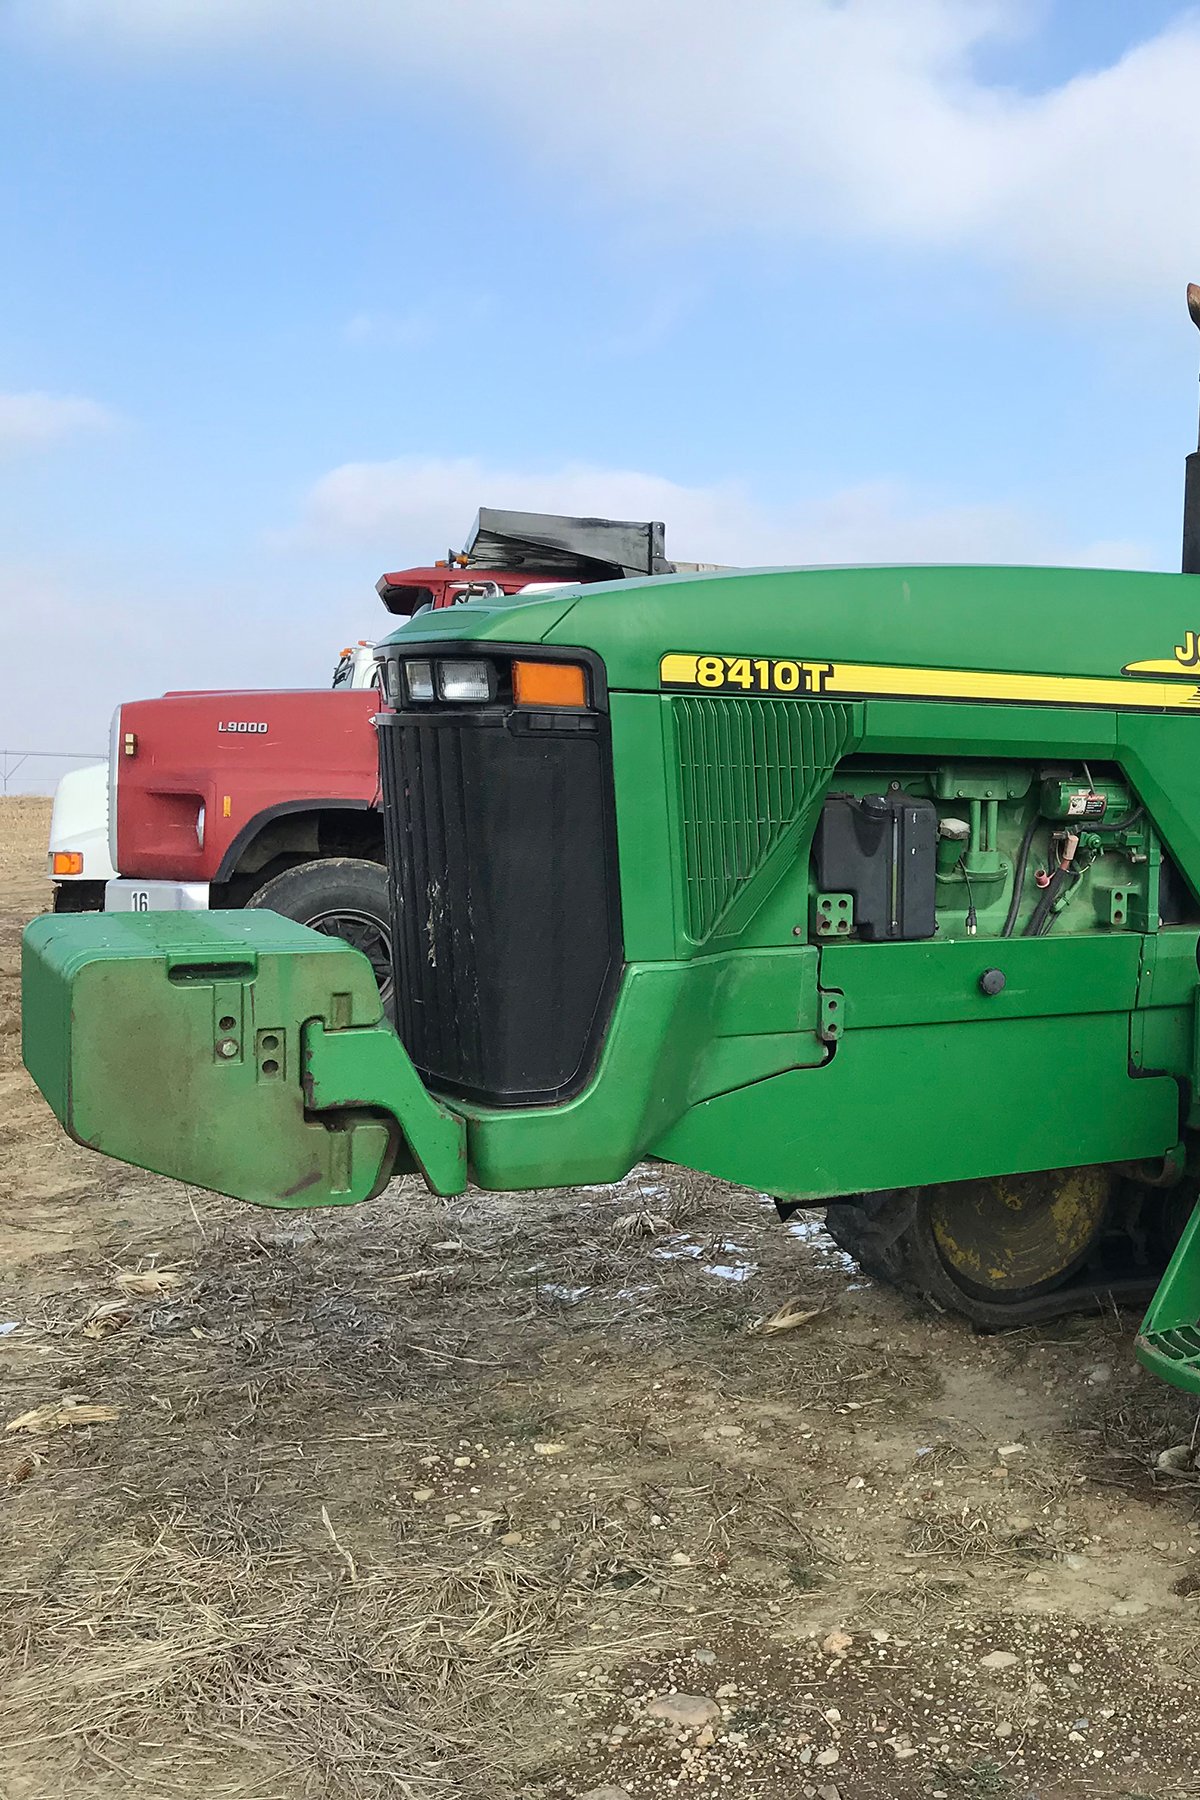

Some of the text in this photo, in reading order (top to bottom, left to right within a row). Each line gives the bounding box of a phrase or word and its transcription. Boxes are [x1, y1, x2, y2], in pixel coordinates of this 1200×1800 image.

[696, 655, 831, 693] 8410T
[217, 721, 269, 733] L9000
[132, 892, 148, 911] 16
